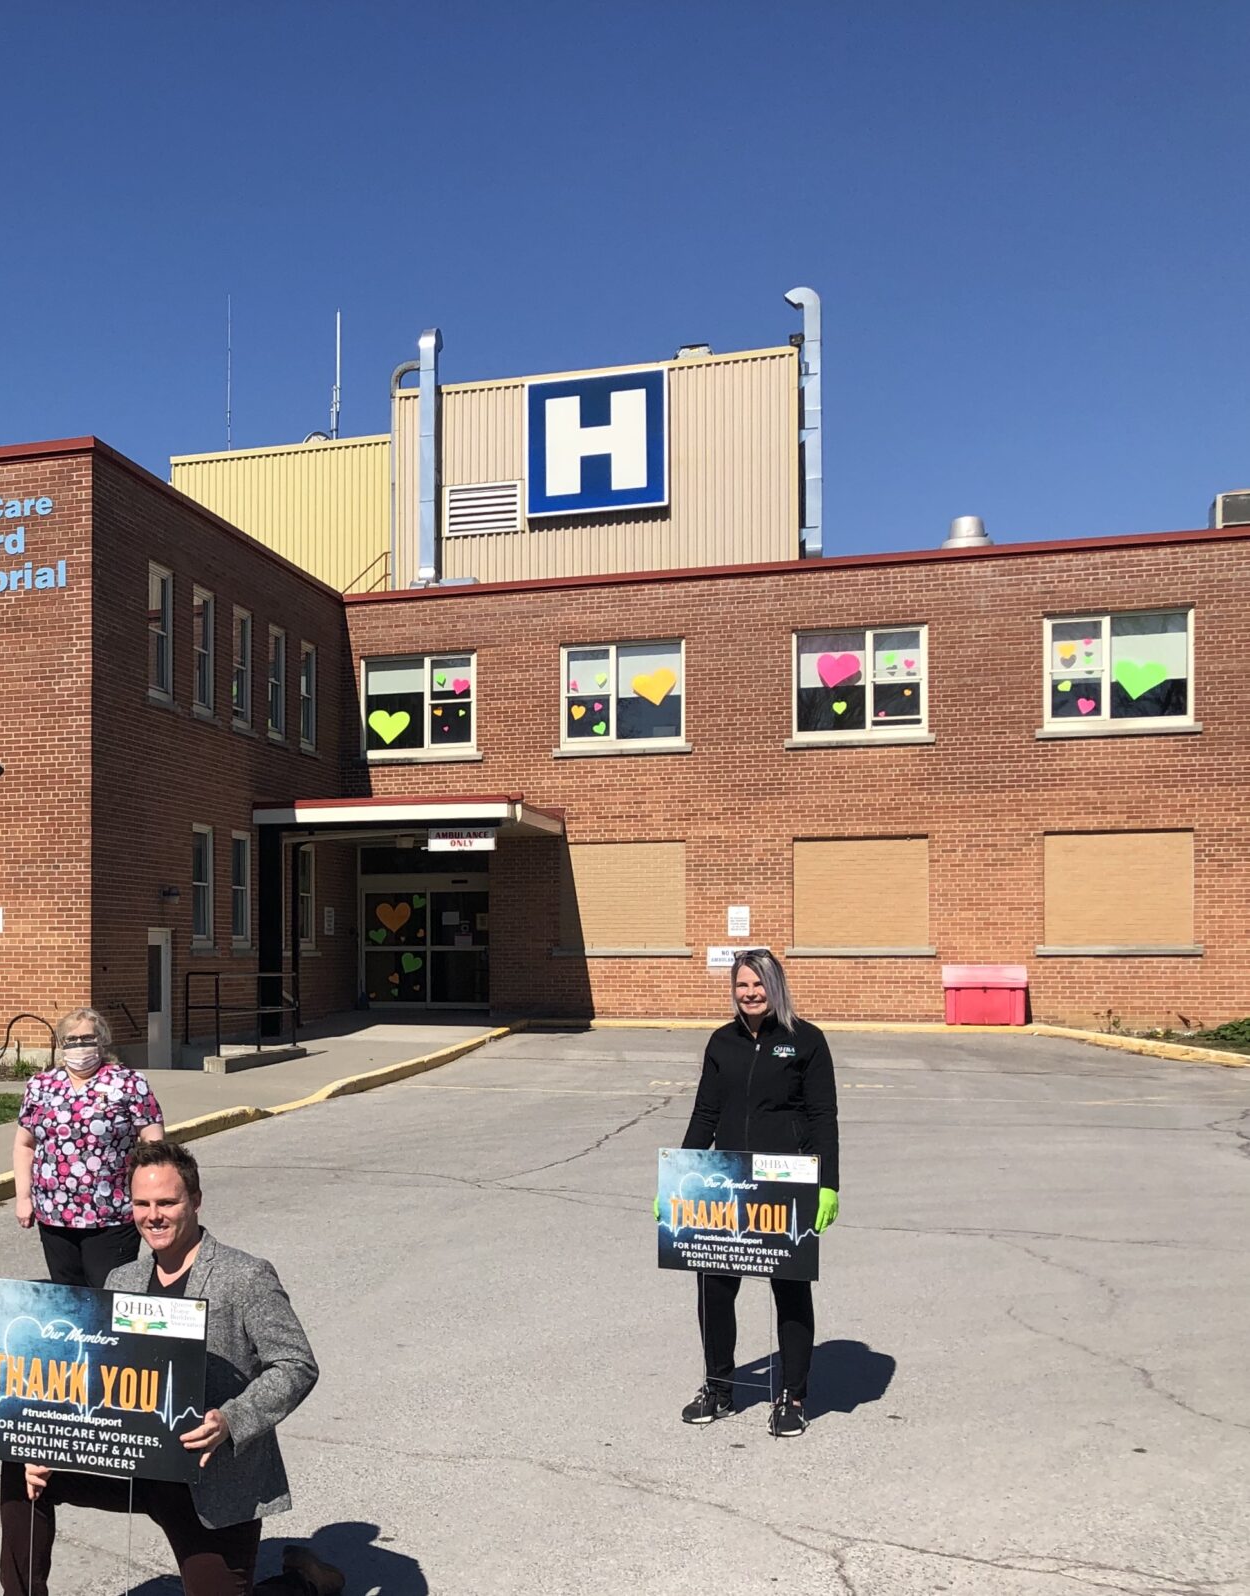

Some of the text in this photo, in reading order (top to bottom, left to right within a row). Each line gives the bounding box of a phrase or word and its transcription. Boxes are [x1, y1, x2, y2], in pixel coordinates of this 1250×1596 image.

[545, 388, 647, 496] H
[435, 831, 489, 839] AMBULANCE
[755, 1159, 789, 1170] QHBA
[671, 1199, 787, 1233] THANK YOU
[682, 1251, 726, 1261] FRONTLINE
[691, 1243, 744, 1253] HEALTHCARE
[747, 1248, 791, 1257] WORKERS,
[688, 1260, 773, 1273] ESSENTIAL WORKERS
[116, 1302, 164, 1317] QHBA
[41, 1326, 120, 1346] Our Members
[101, 1365, 158, 1412] YOU
[22, 1407, 122, 1427] #truckloadofsupport
[3, 1432, 145, 1458] FRONTLINE STAFF & ALL
[17, 1423, 95, 1440] HEALTHCARE
[99, 1431, 162, 1449] WORKERS,
[11, 1446, 136, 1470] ESSENTIAL WORKERS
